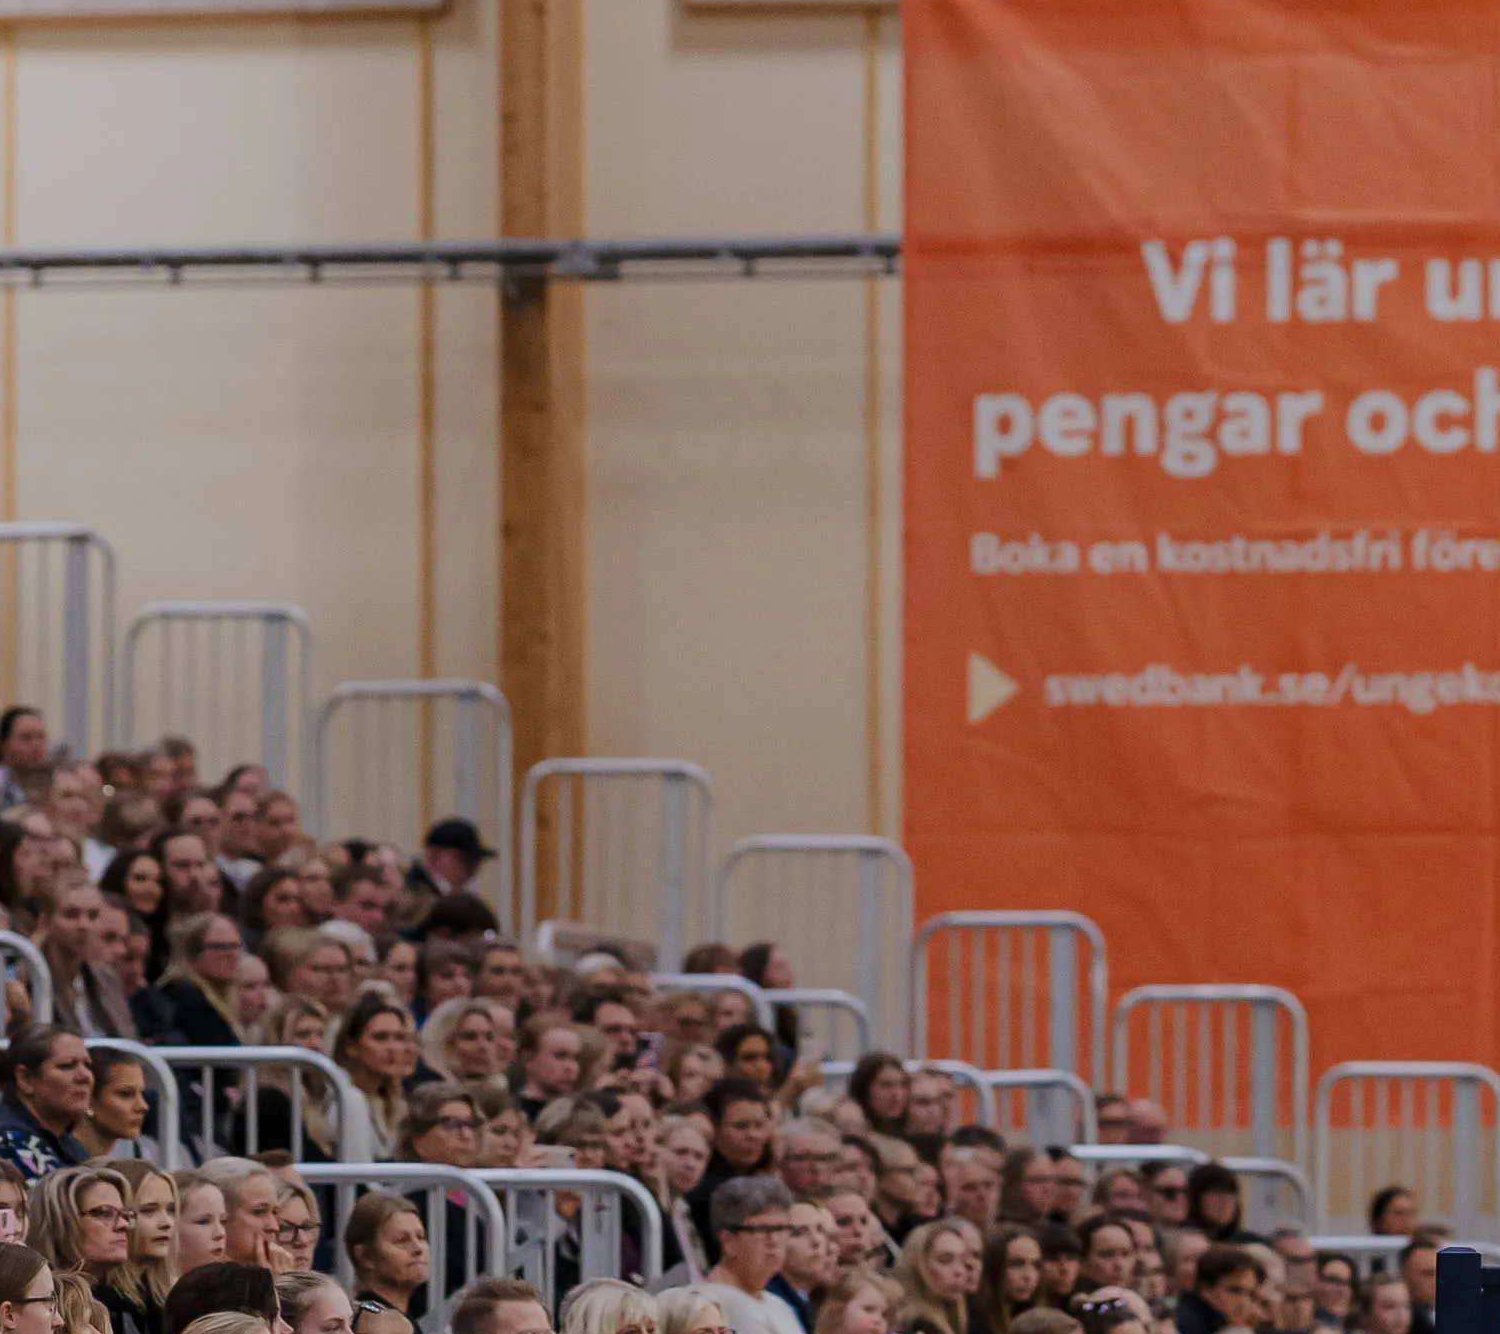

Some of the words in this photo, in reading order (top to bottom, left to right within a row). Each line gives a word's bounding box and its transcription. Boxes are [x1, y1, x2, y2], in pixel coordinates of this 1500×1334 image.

[1140, 237, 1236, 324] Vi
[1266, 237, 1398, 323] lär
[971, 389, 1324, 478] pengar
[970, 531, 1080, 574] Boka
[1088, 540, 1149, 573] en
[1156, 531, 1402, 573] kostnadsfri
